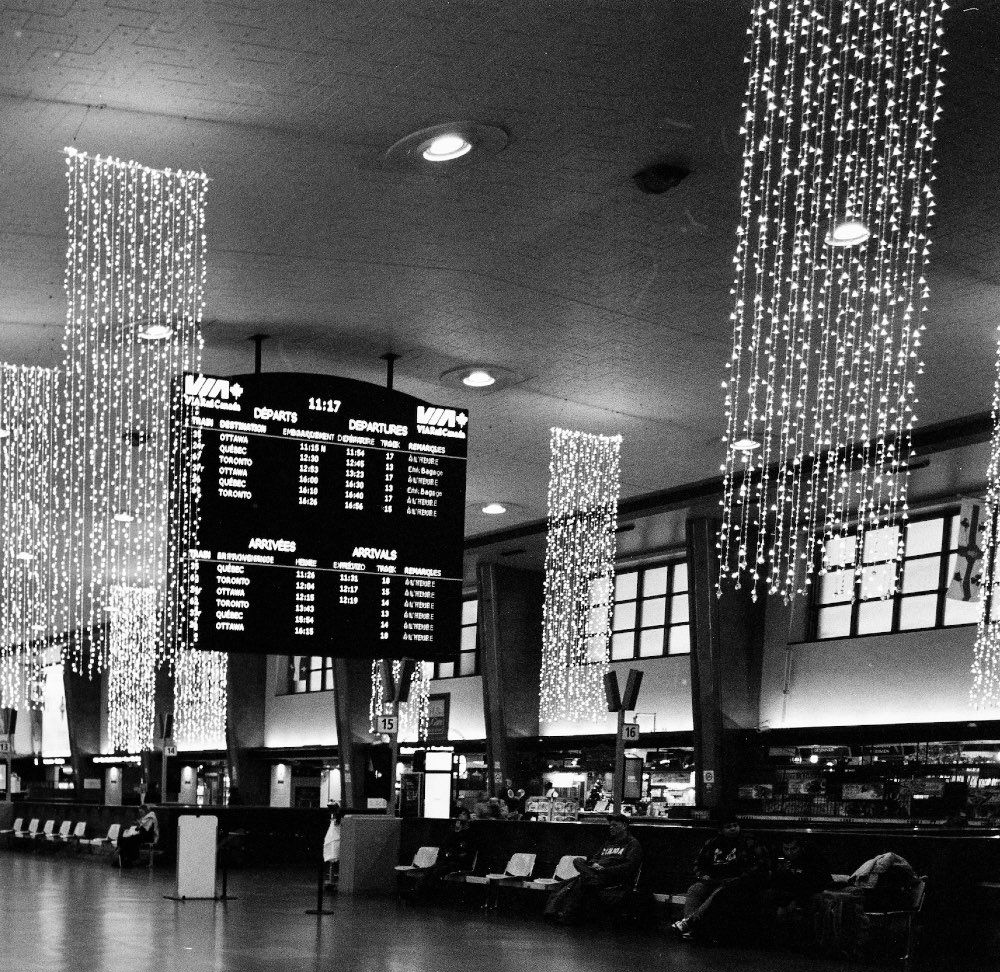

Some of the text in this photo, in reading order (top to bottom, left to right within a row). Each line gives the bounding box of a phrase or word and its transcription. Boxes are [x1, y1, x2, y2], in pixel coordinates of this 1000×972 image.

[309, 397, 341, 413] 11:17
[254, 406, 298, 423] DÉPARTS
[349, 419, 408, 436] DEPARTURES
[220, 433, 249, 444] OTTAWA
[346, 448, 365, 457] 11:54
[219, 444, 247, 455] QUÉBEC
[299, 454, 319, 463] 12:30
[346, 459, 365, 468] 12:45
[385, 463, 394, 471] 13
[219, 455, 253, 466] TORONTO
[345, 470, 364, 478] 13:23
[385, 474, 393, 482] 17
[219, 467, 248, 477] OTTAWA
[299, 475, 319, 484] 16:00
[345, 480, 364, 489] 16:30
[385, 484, 393, 492] 13
[218, 488, 252, 500] TORONTO
[219, 477, 246, 488] QUÉBEC
[298, 486, 318, 495] 16:10
[345, 491, 364, 500] 16:40
[385, 495, 393, 503] 17
[248, 538, 297, 552] ARRIVÉES
[352, 547, 398, 561] ARRIVALS
[217, 563, 244, 573] QUÉBEC
[216, 576, 250, 586] TORONTO
[296, 582, 315, 590] 12:04
[339, 585, 358, 593] 12:17
[216, 587, 245, 597] OTTAWA
[339, 596, 358, 605] 12:19
[216, 599, 249, 608] TORONTO
[381, 610, 389, 618] 13
[216, 610, 243, 620] QUÉBEC
[216, 622, 244, 631] OTTAWA
[382, 719, 394, 730] 15
[625, 727, 636, 738] 16
[0, 743, 8, 751] 13
